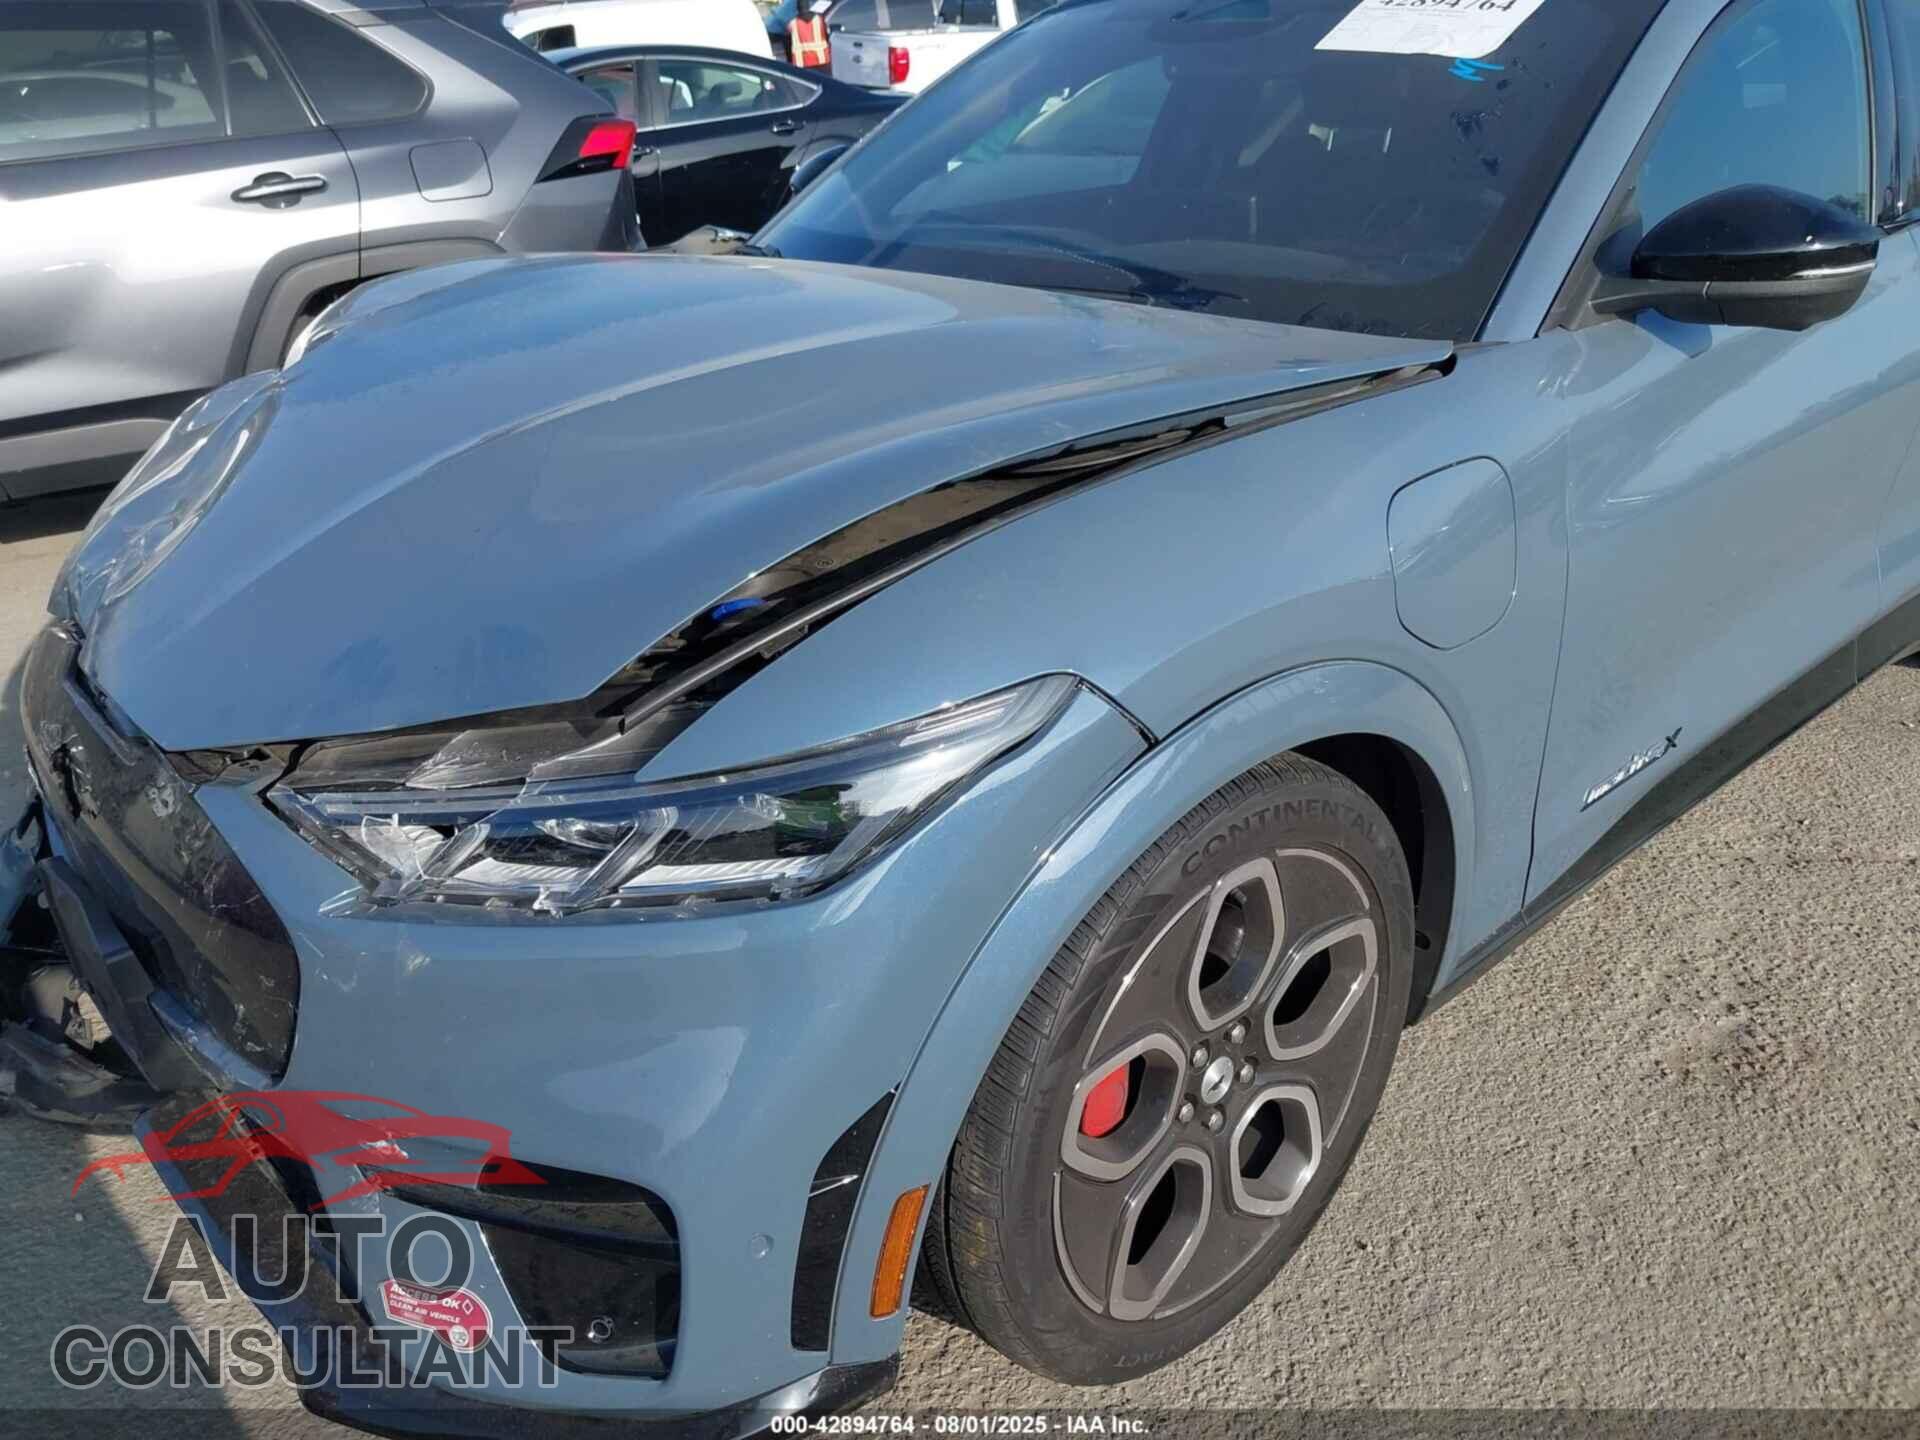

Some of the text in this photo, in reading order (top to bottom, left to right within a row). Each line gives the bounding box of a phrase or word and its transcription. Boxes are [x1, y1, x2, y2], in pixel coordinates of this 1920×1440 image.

[1181, 800, 1377, 877] CONTINENTAL
[390, 1283, 438, 1304] ACCESS
[442, 1298, 461, 1310] OK
[390, 1299, 413, 1314] CLEAN
[414, 1307, 428, 1316] AIR
[430, 1311, 461, 1323] VEHICLE
